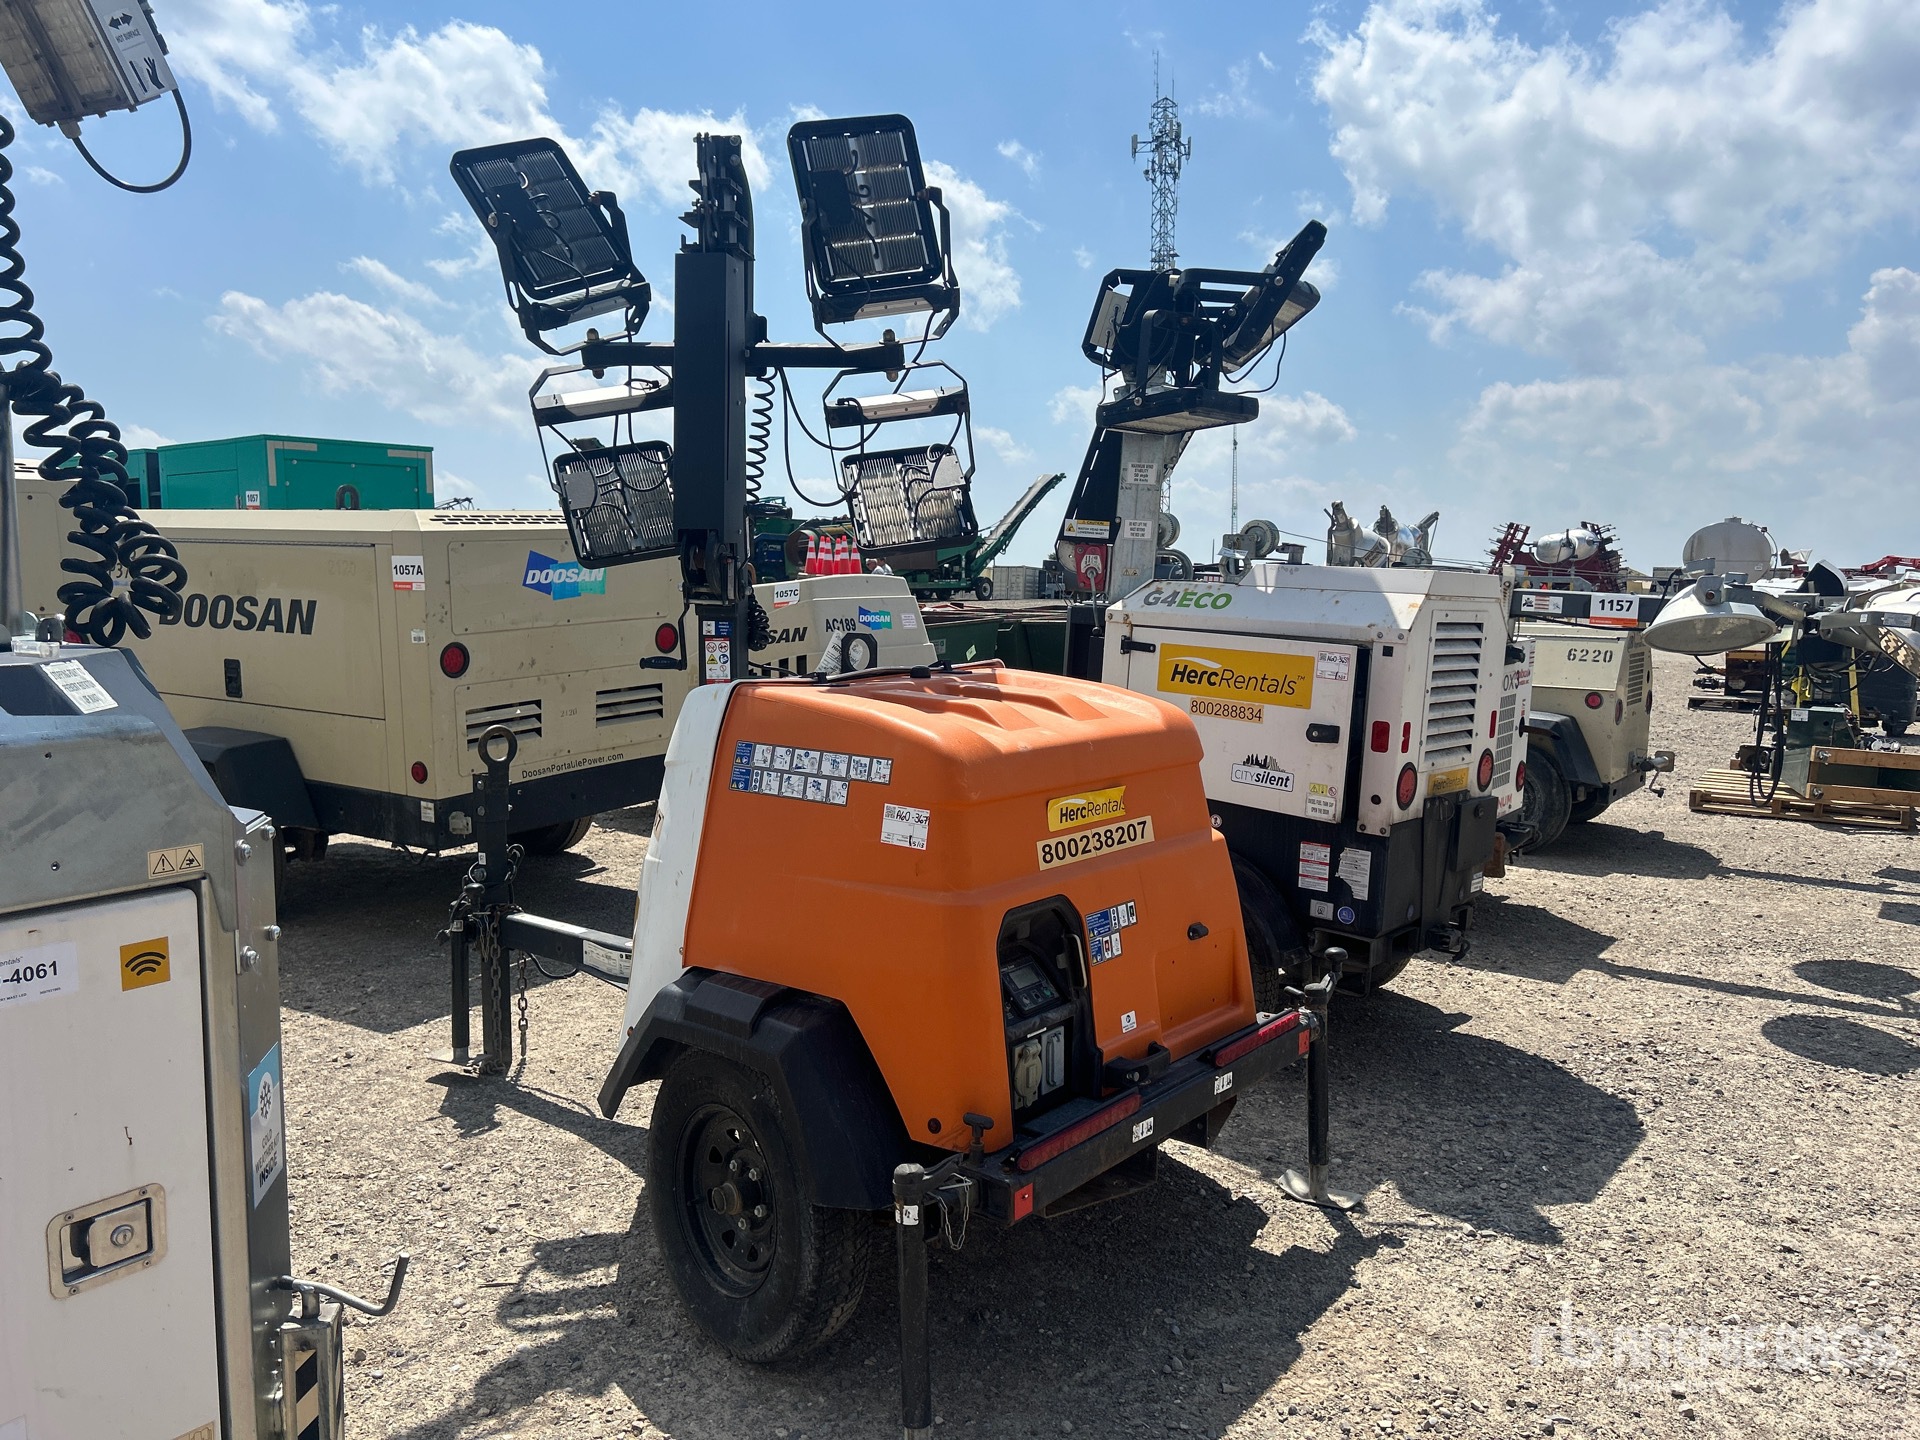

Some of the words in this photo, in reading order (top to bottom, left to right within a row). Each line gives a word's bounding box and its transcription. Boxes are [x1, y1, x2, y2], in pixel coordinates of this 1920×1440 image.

[393, 564, 423, 576] 1057A
[525, 566, 605, 585] DOOSAN
[775, 588, 799, 599] 1057C
[1143, 590, 1233, 610] G4ECO
[1598, 599, 1634, 612] 1157
[825, 618, 857, 633] AC189
[859, 614, 891, 624] DOOSAN
[1567, 647, 1614, 663] 6220
[1190, 699, 1263, 722] 800288834
[1234, 769, 1290, 788] CITYsilent
[1041, 820, 1148, 865] 800238207
[262, 1128, 273, 1149] COLD
[255, 1141, 274, 1174] WEATHER
[259, 1150, 278, 1189] INSIDE
